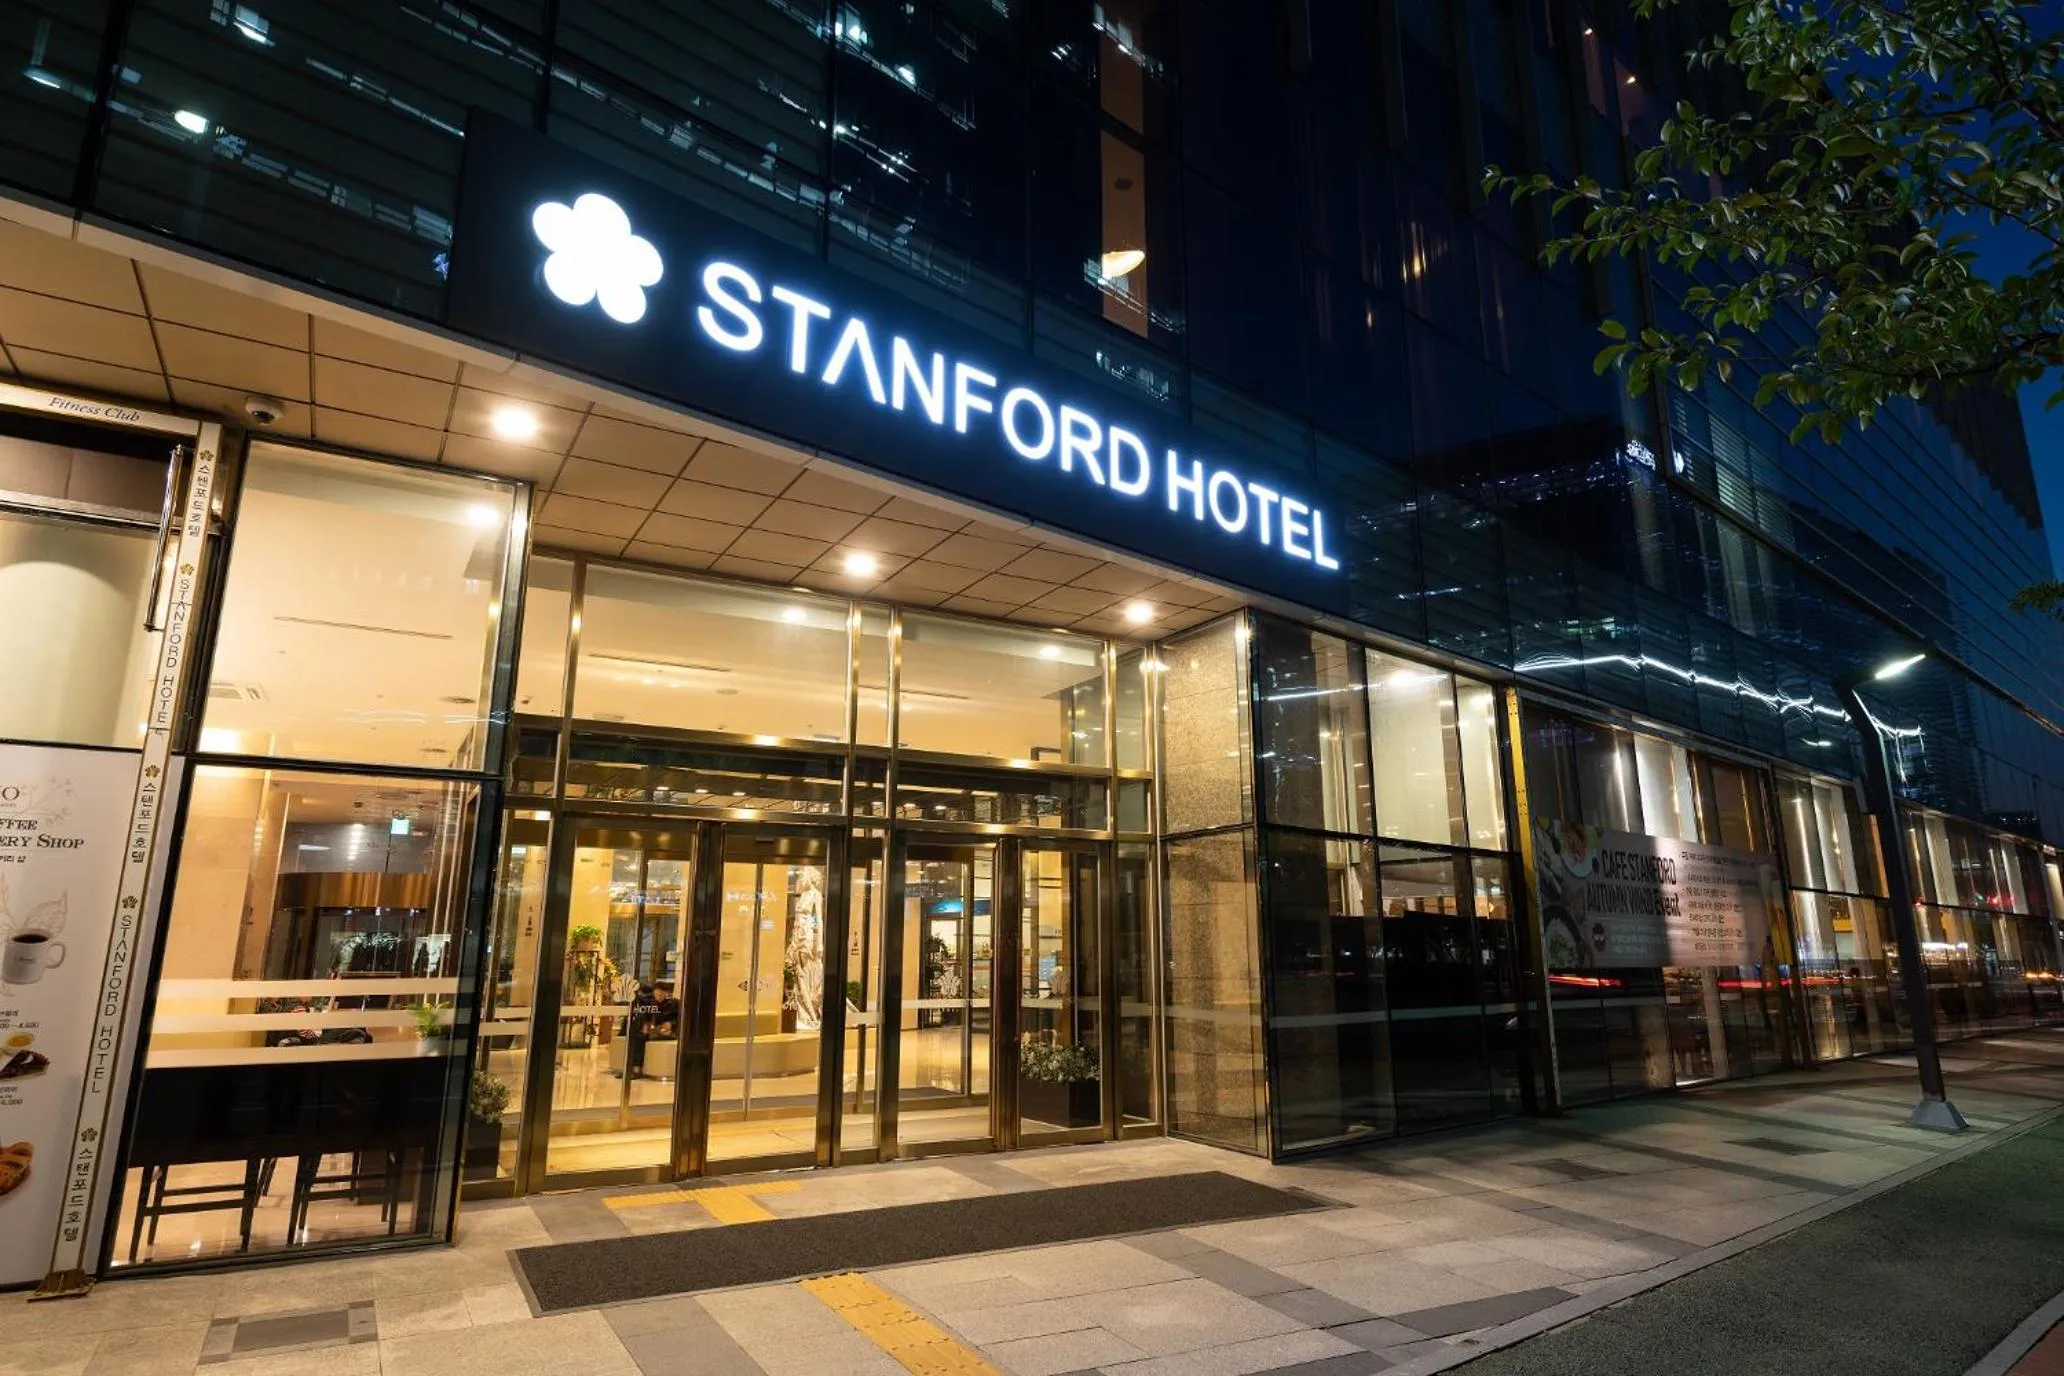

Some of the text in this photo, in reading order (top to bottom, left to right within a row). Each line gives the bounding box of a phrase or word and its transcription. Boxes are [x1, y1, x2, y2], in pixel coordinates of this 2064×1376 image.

[50, 396, 140, 422] Fitness Club
[697, 261, 1340, 571] STANFORD HOTEL
[166, 578, 191, 668] STANFORD
[1601, 848, 1628, 881] CAFE
[91, 914, 132, 1094] STANFORD HOTEL
